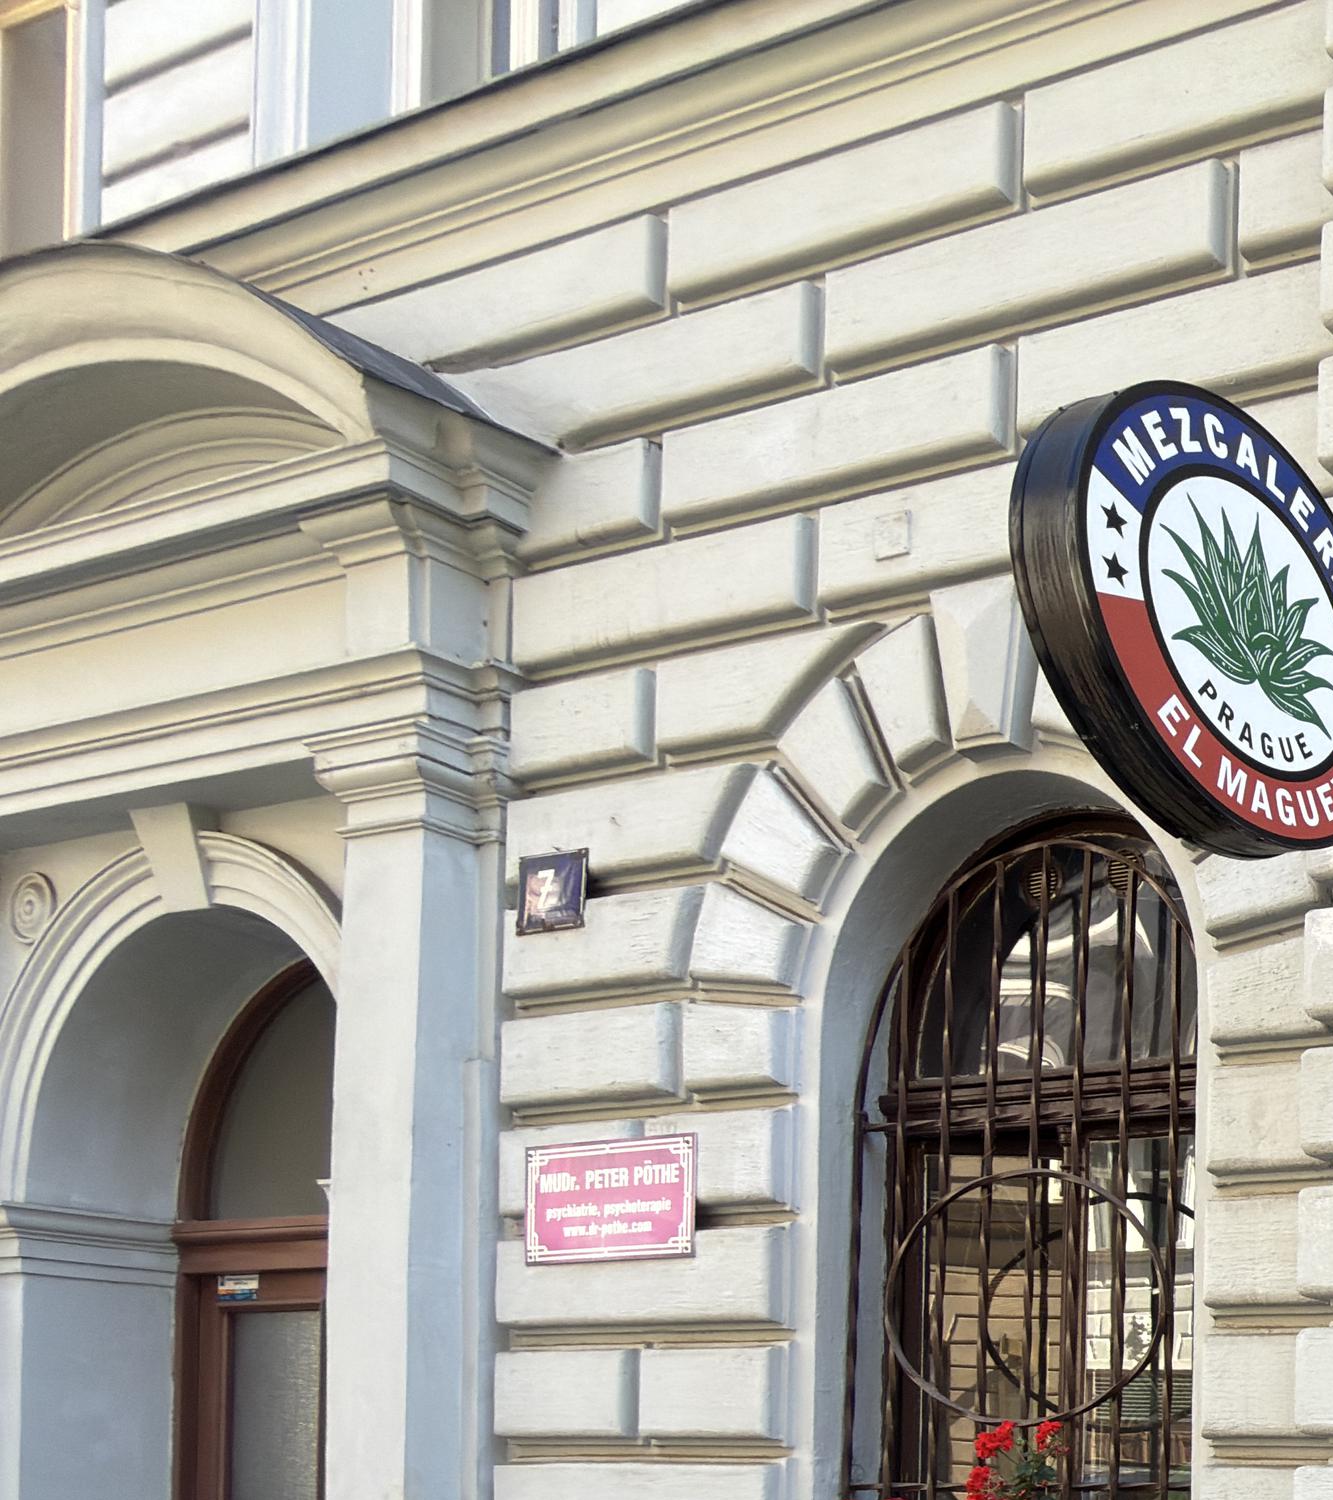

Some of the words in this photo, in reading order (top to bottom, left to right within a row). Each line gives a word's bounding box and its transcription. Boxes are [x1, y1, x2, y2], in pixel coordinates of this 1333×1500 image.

[1157, 693, 1205, 768] EL
[1198, 678, 1313, 763] PRAGUE
[539, 1171, 580, 1193] MUDr.
[585, 1166, 629, 1190] PETER
[546, 1202, 601, 1222] psychiatrie,
[603, 1197, 672, 1218] psychoterapie
